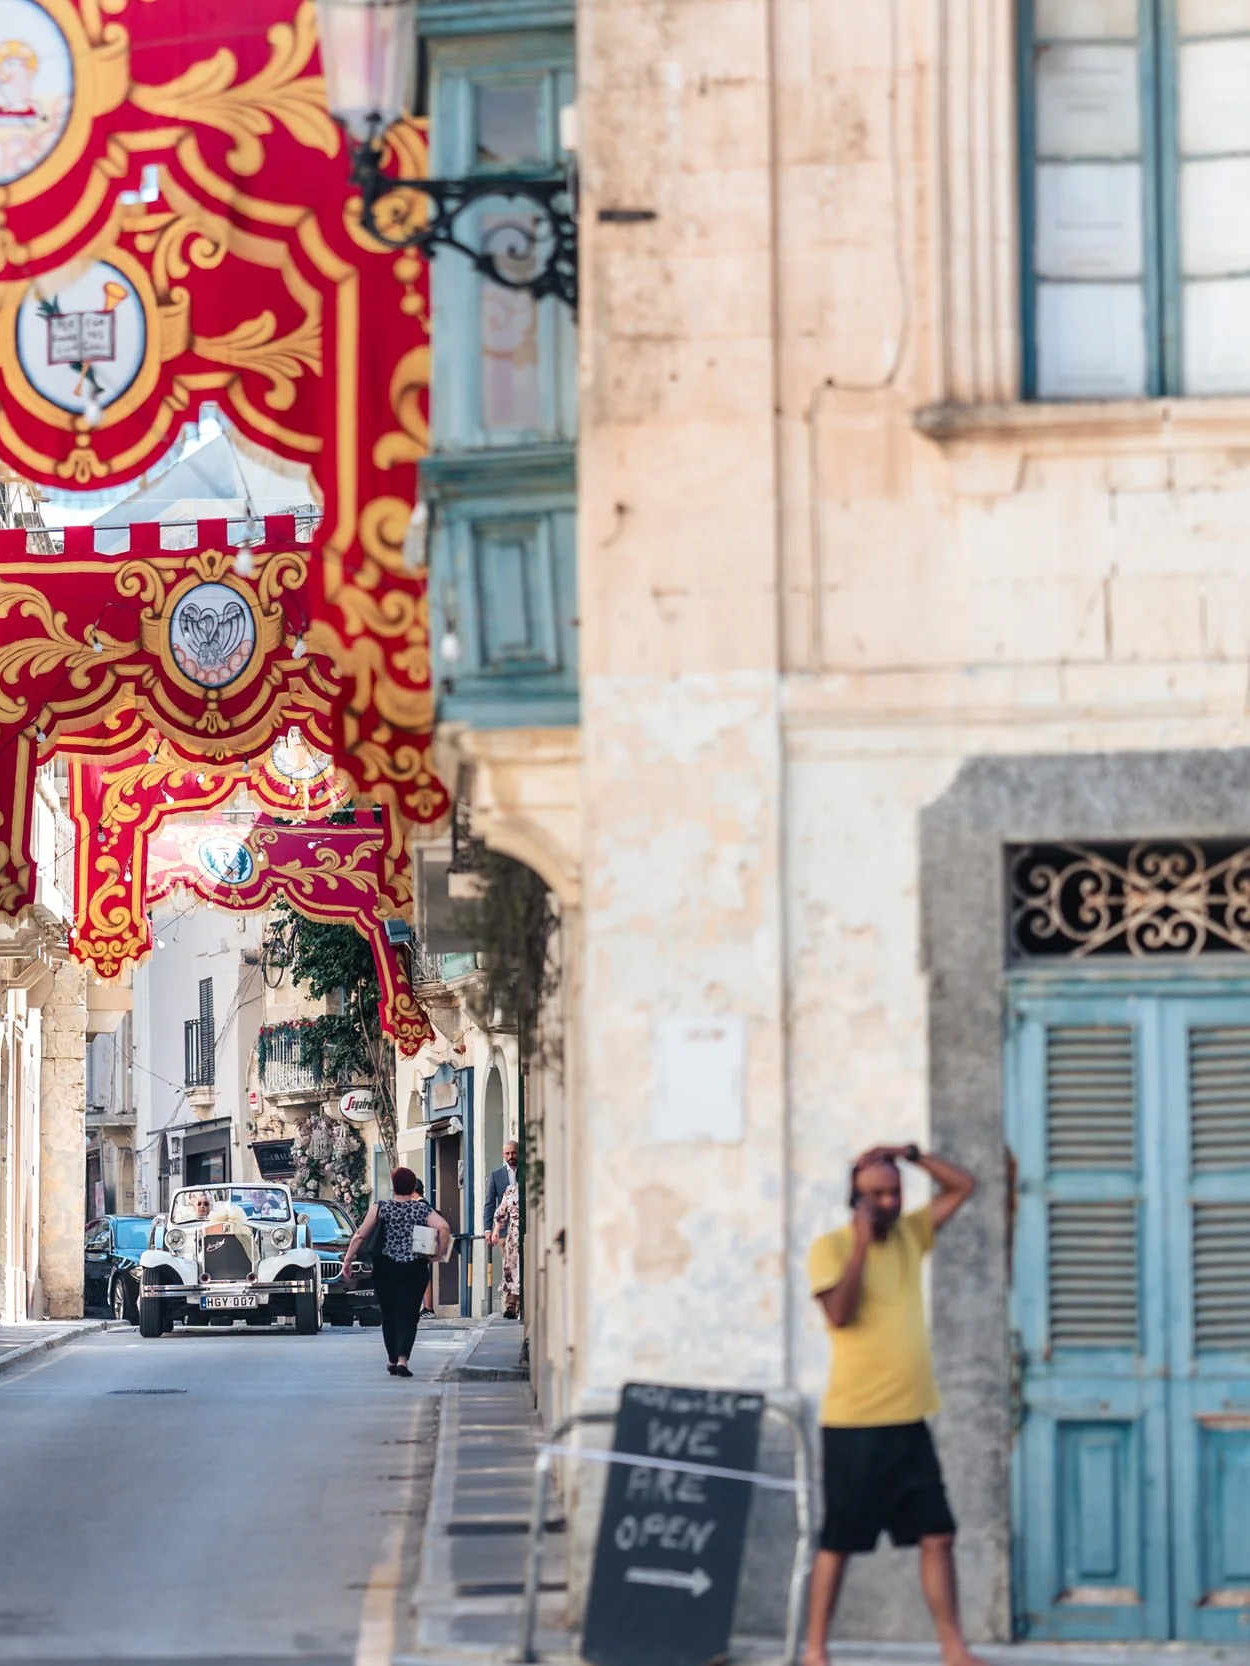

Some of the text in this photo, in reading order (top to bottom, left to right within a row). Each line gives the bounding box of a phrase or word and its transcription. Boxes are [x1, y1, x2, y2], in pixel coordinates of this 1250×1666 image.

[207, 1296, 254, 1307] HGY 007
[647, 1419, 721, 1456] WE
[627, 1466, 707, 1504] ARE
[614, 1513, 716, 1553] OPEN
